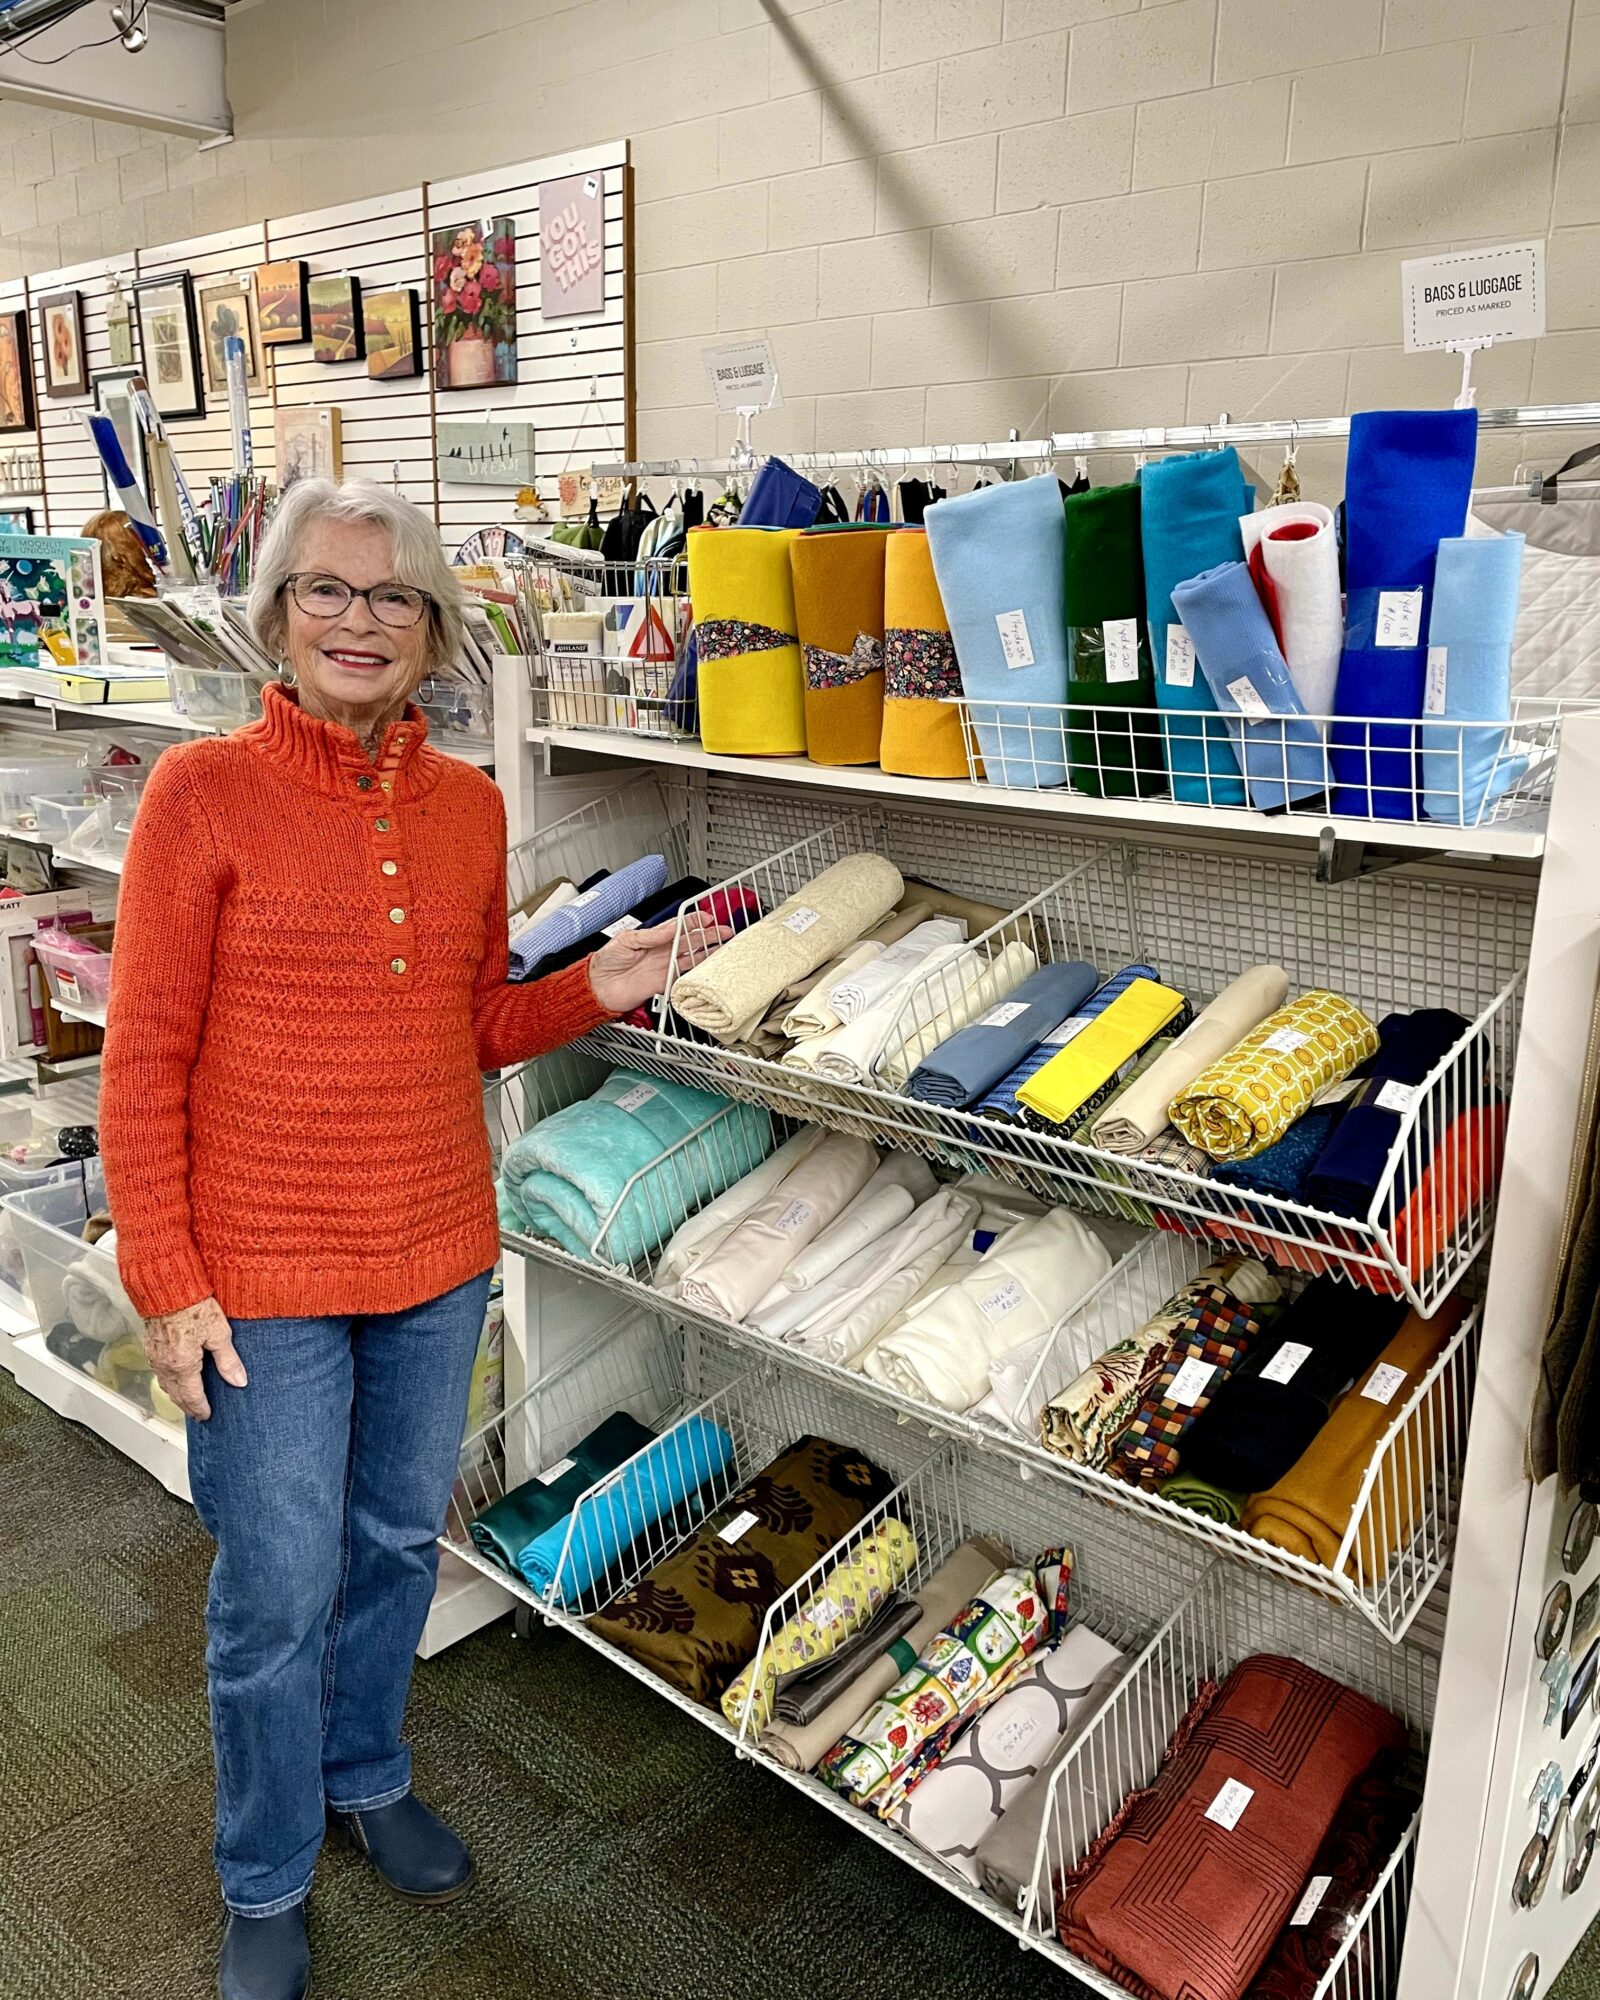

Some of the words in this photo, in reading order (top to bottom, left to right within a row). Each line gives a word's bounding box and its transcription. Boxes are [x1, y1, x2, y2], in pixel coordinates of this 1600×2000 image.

[541, 201, 579, 252] YOU
[549, 220, 586, 271] GOT
[555, 239, 601, 292] THIS
[1424, 284, 1455, 303] BAGS
[1458, 282, 1466, 298] &
[1469, 274, 1522, 297] LUGGAGE
[1435, 307, 1464, 317] PRICED
[1466, 304, 1476, 313] AS
[1478, 300, 1512, 311] MARKED
[467, 458, 519, 476] DREAM
[19, 539, 62, 549] MOONLIT
[20, 547, 64, 556] UNICORN
[556, 644, 587, 652] ASHLAND
